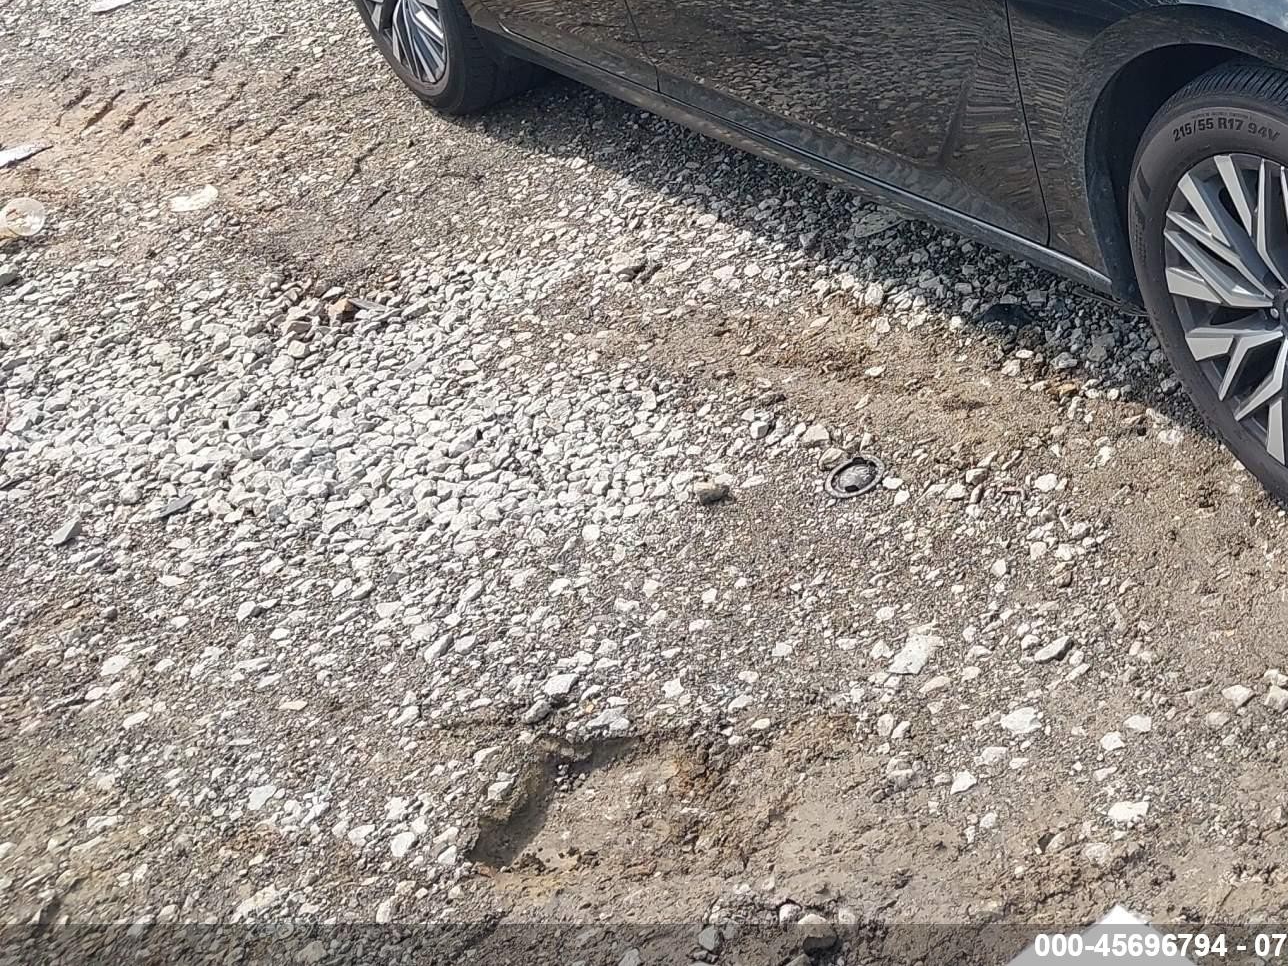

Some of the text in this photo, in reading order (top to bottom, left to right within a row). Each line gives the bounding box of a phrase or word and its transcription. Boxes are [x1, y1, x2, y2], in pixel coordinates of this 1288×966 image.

[1172, 117, 1214, 143] 215/55
[1217, 117, 1244, 131] R17
[1247, 122, 1281, 142] 94V
